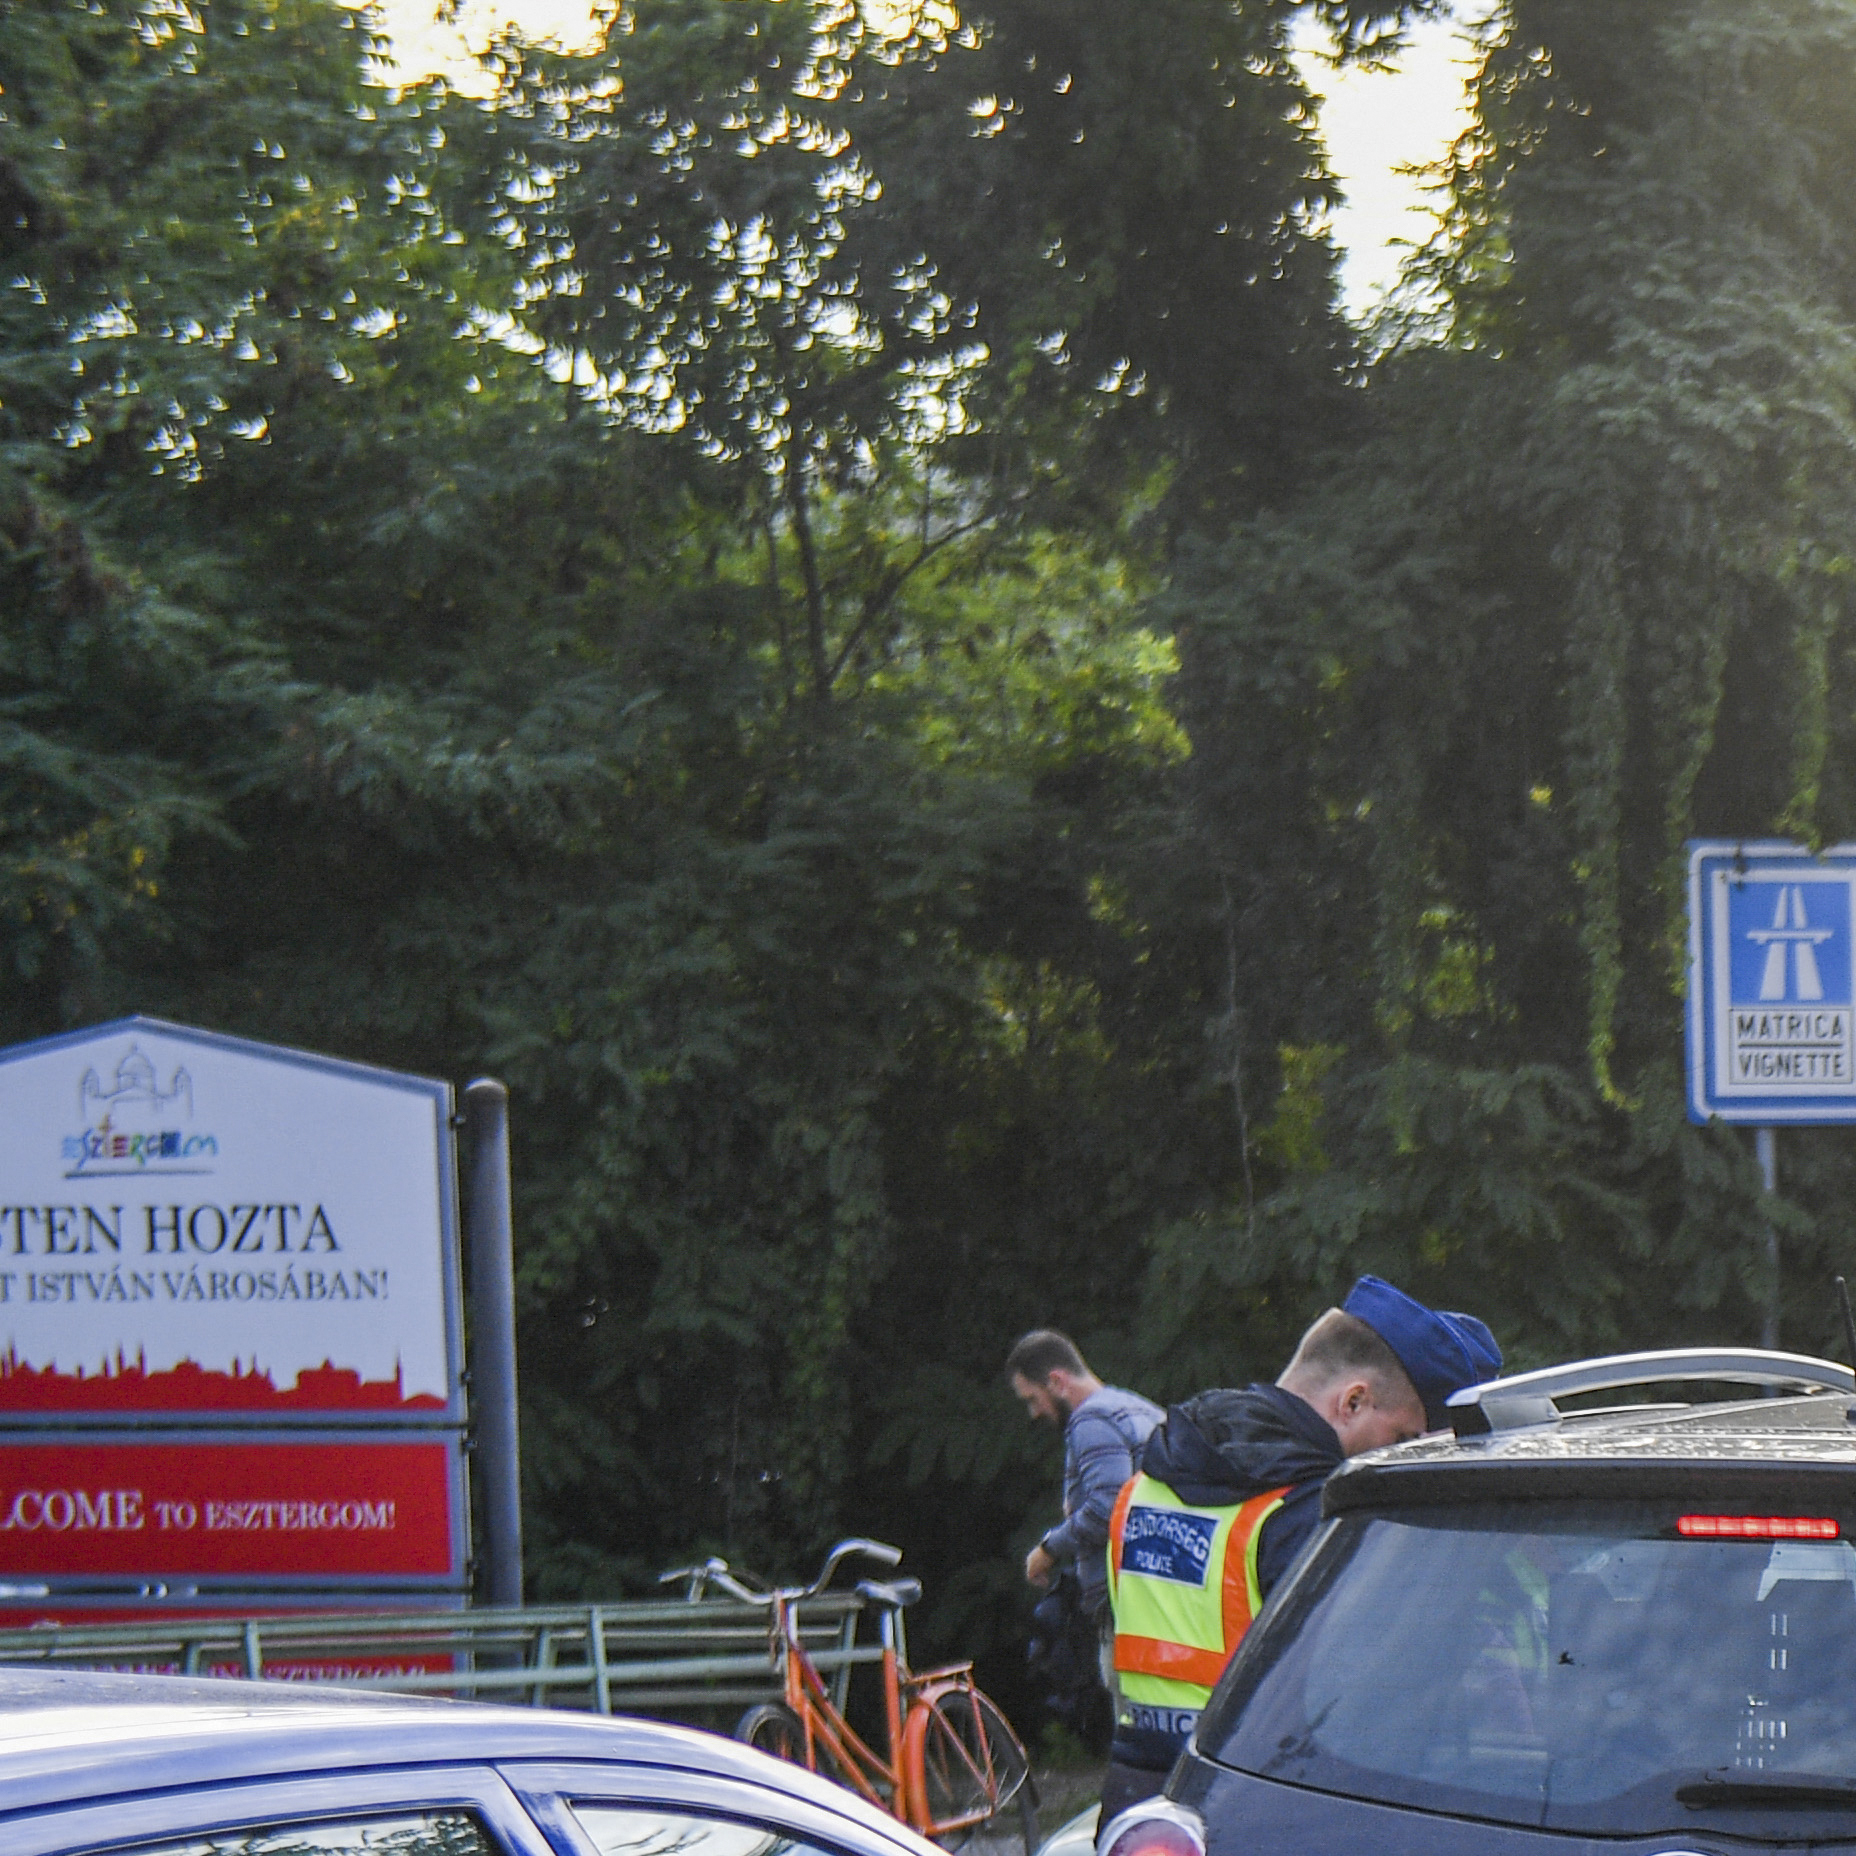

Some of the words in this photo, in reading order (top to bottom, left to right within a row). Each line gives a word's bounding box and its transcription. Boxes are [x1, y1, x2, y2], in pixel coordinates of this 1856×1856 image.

[1737, 1015, 1842, 1039] MATRICA
[1739, 1053, 1845, 1077] VIGNETTE
[0, 1203, 122, 1253] TEN
[142, 1203, 342, 1253] HOZTA
[25, 1264, 155, 1301] ISTVÁN
[162, 1263, 389, 1301] VÁROSÁBAN!
[155, 1503, 197, 1529] TO
[205, 1500, 397, 1530] ESZTERGOM!
[1130, 1706, 1200, 1734] POLIC
